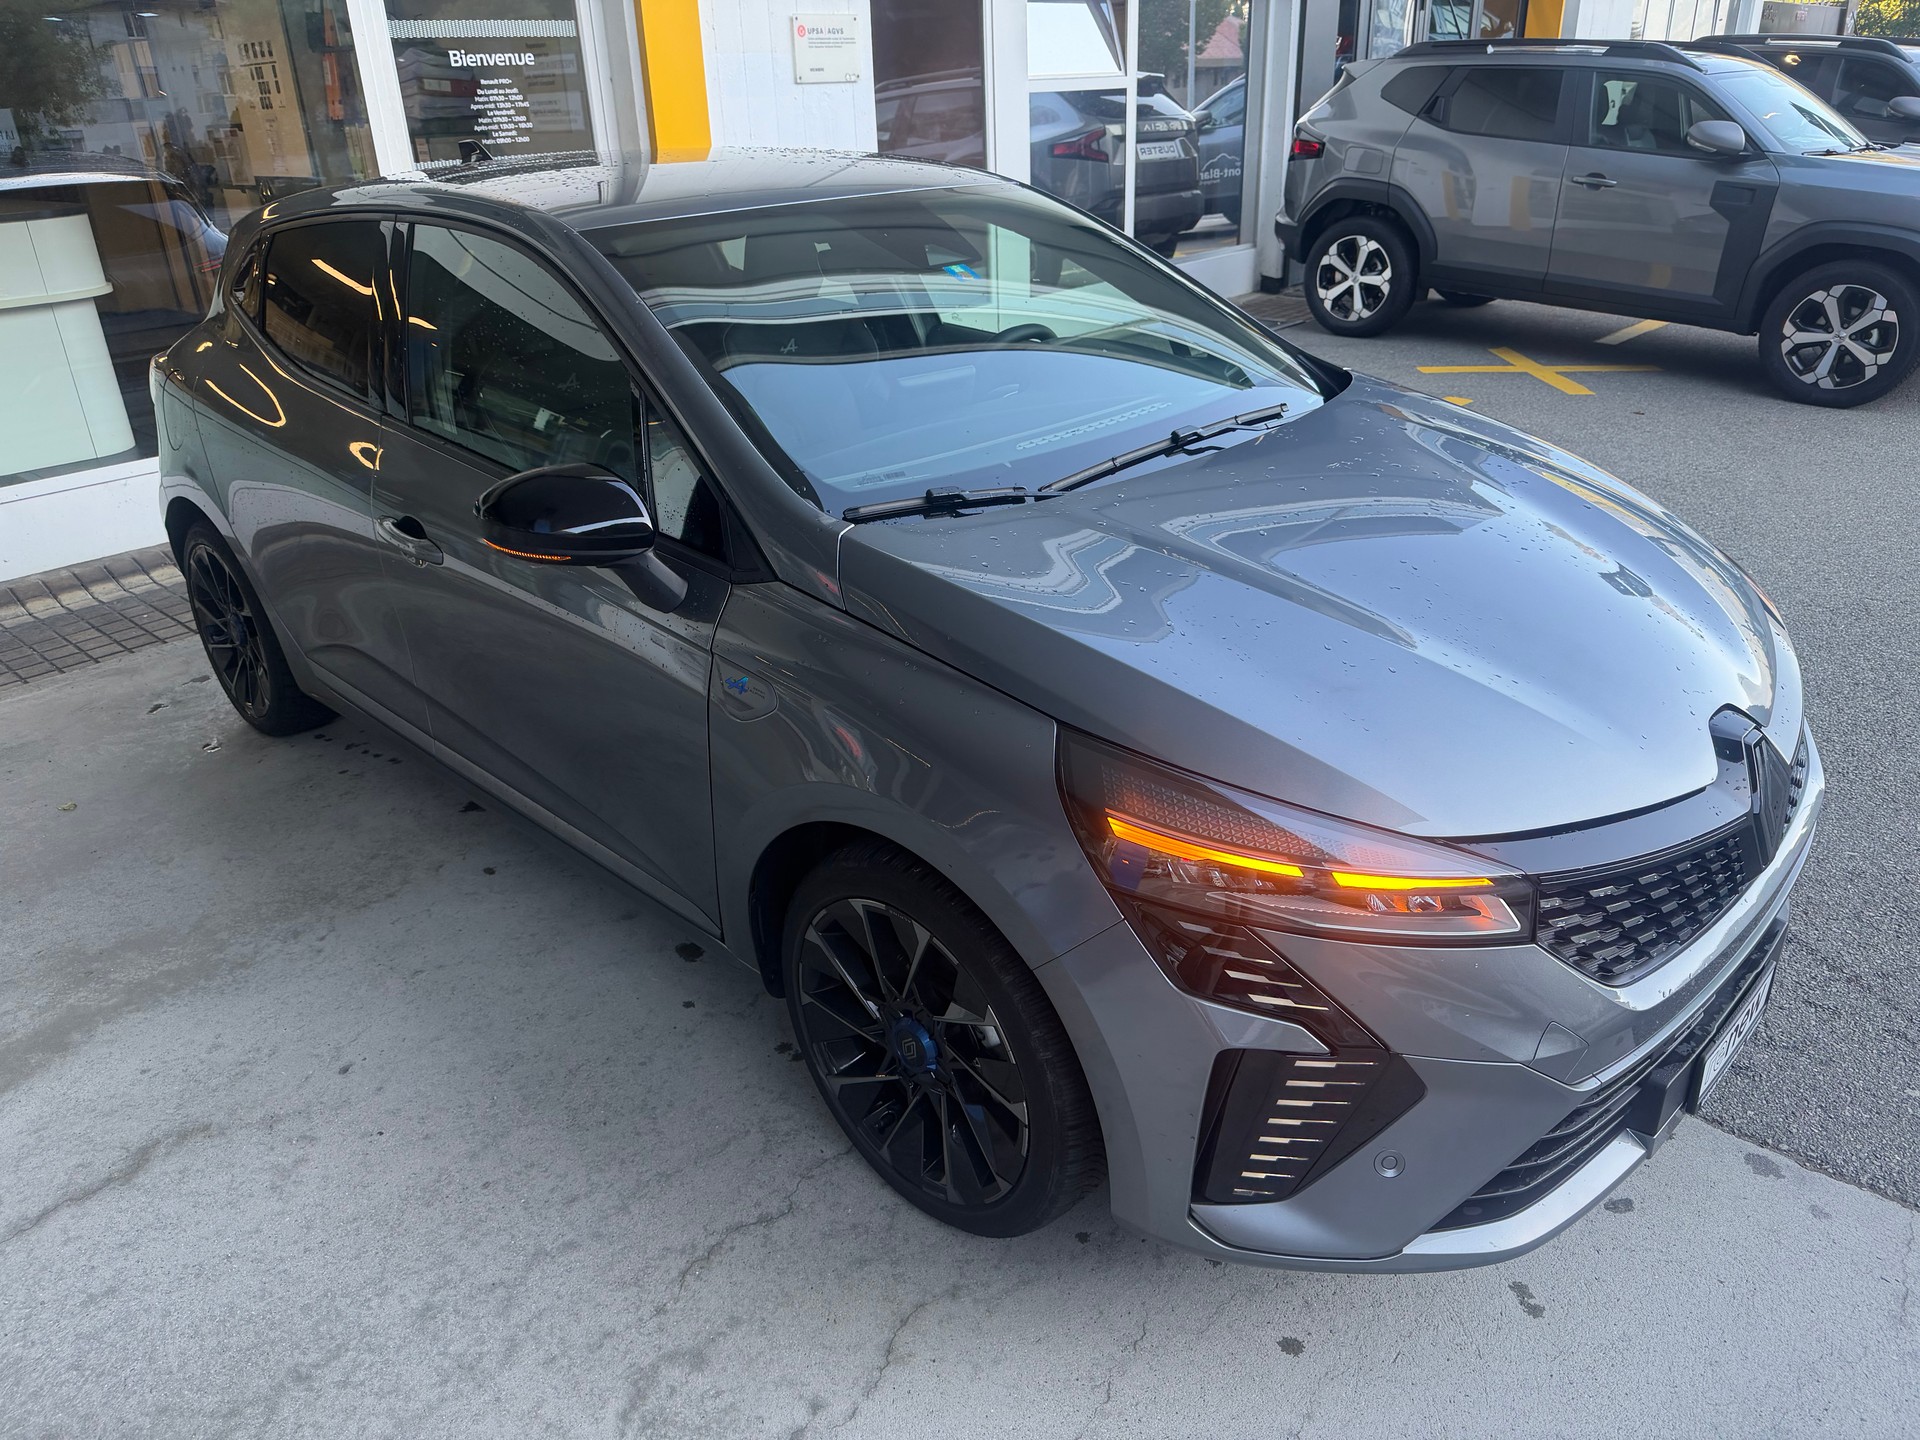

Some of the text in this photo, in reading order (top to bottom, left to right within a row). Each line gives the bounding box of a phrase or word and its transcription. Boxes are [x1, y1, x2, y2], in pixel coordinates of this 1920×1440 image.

[807, 27, 844, 35] UPSA AGVS
[448, 49, 535, 67] Bienvenue
